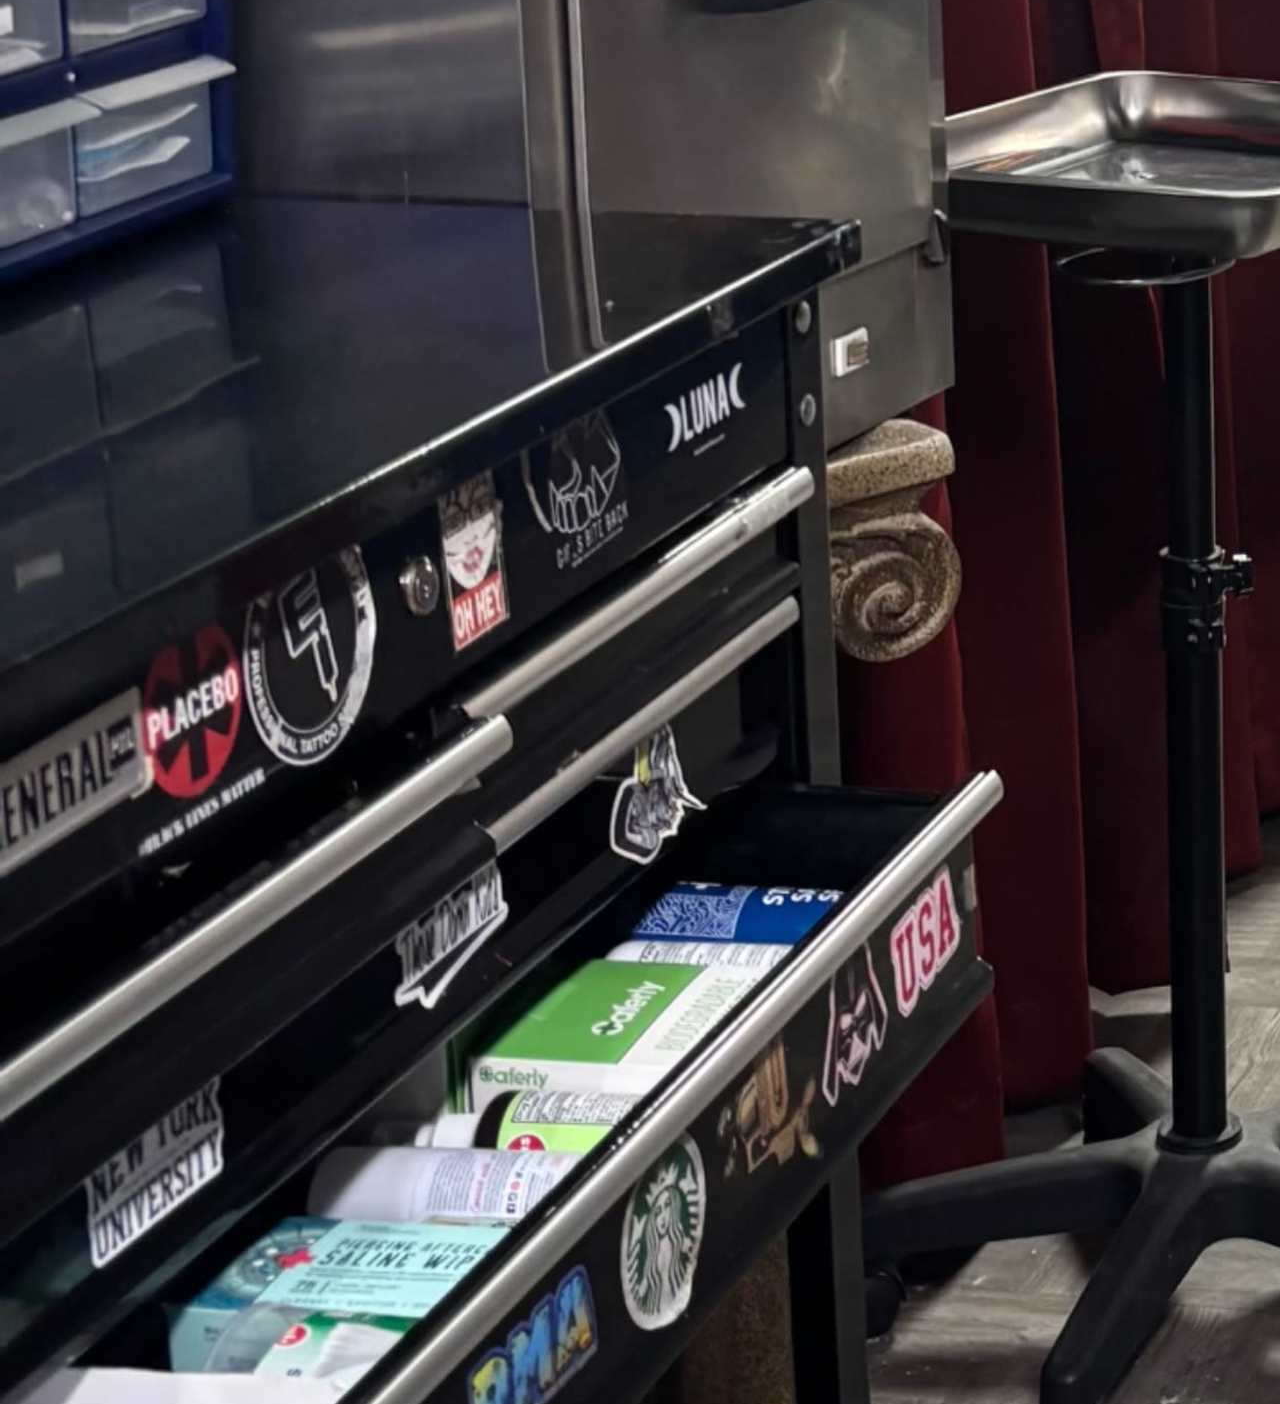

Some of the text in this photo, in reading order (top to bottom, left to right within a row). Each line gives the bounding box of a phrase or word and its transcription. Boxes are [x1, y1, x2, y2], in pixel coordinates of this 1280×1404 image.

[680, 373, 730, 442] LUNA
[455, 578, 503, 640] OH HEY
[147, 668, 239, 751] PLACEBO
[300, 722, 339, 755] TATTOO
[1, 731, 114, 845] ENERAL
[895, 878, 956, 1004] USA
[479, 1066, 549, 1089] Saferly
[96, 1127, 220, 1259] UNIVERSITY
[319, 1249, 477, 1271] SALINE WIP
[421, 1243, 486, 1255] AFTERC
